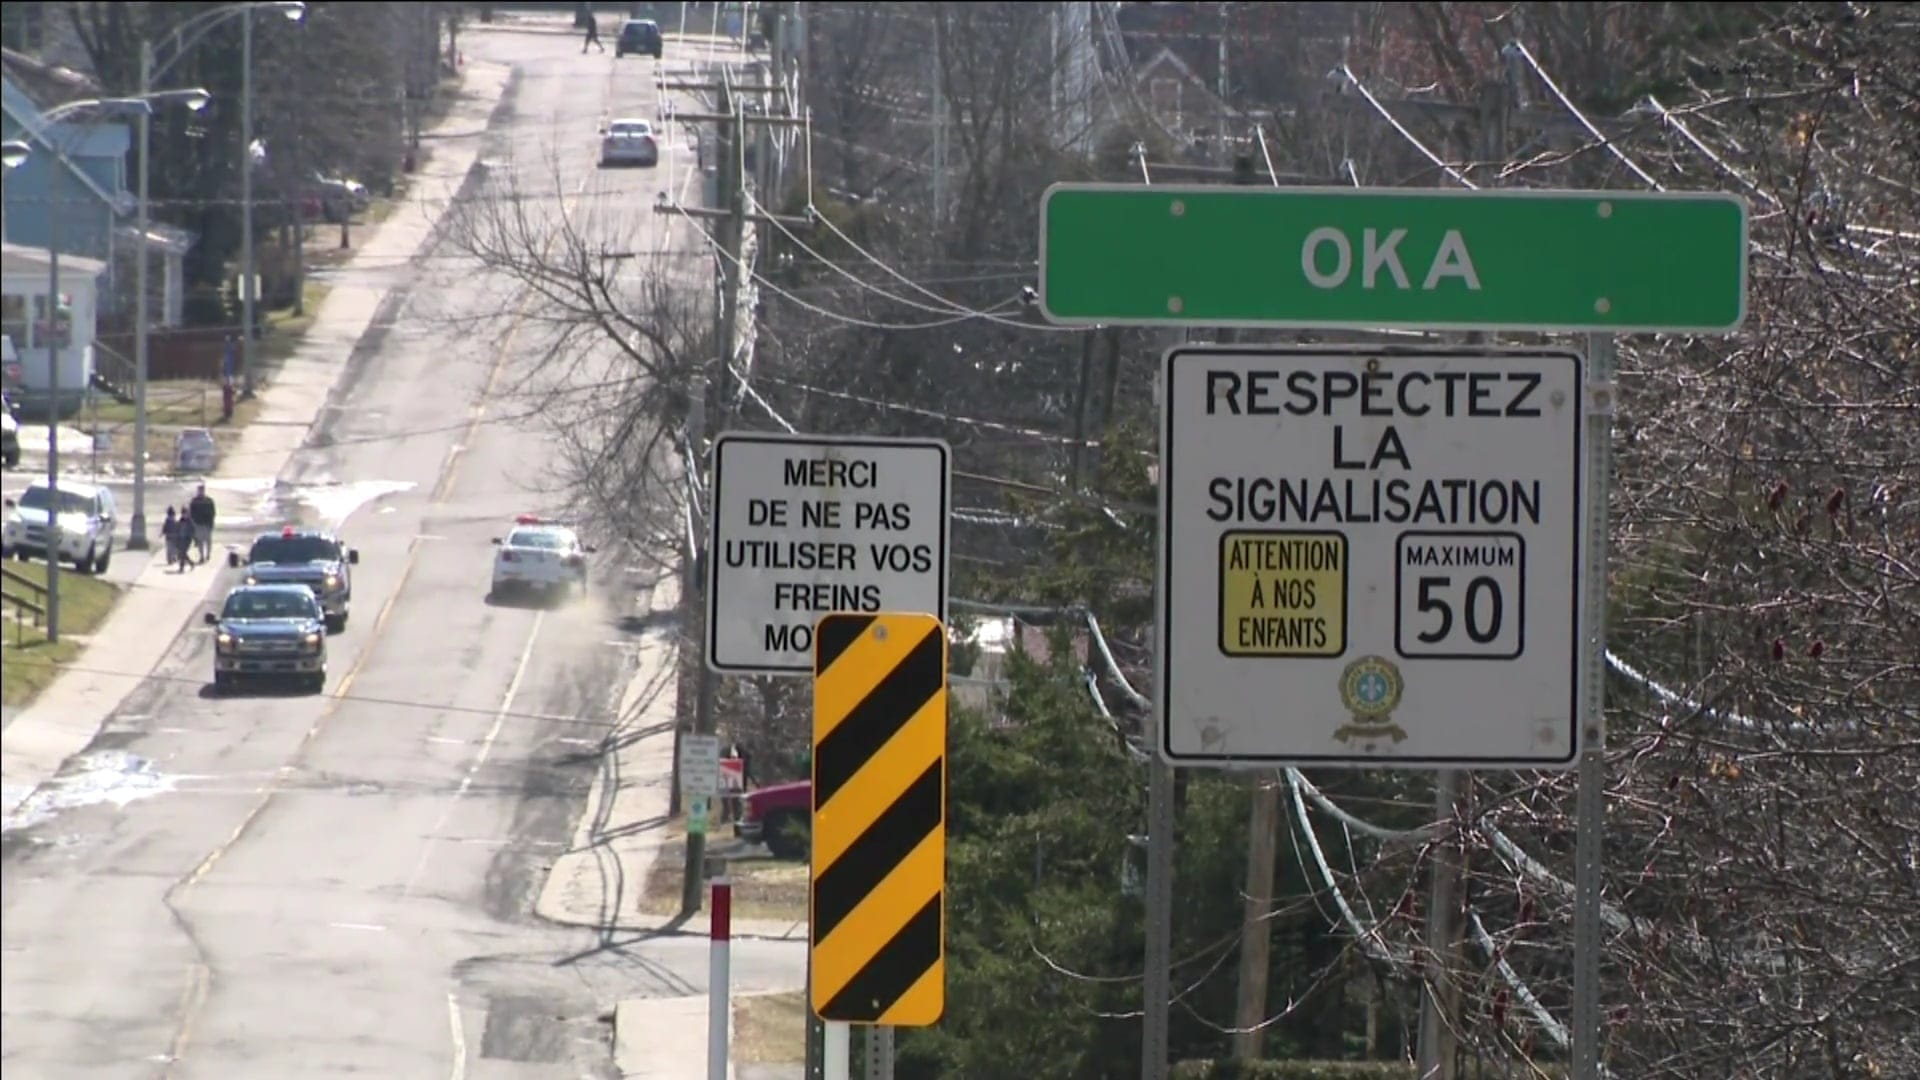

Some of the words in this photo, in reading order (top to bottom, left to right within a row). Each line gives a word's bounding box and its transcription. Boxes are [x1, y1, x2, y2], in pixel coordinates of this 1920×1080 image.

[1301, 226, 1482, 290] OKA
[1206, 370, 1542, 418] RESPECTEZ
[1333, 425, 1412, 470] LA
[784, 459, 877, 488] MERCI
[749, 500, 787, 528] DE
[802, 501, 841, 529] NE
[855, 503, 911, 531] PAS
[1206, 478, 1540, 525] SIGNALISATION
[726, 540, 856, 571] UTILISER
[871, 544, 932, 573] VOS
[1229, 540, 1339, 571] ATTENTION
[1407, 546, 1514, 567] MAXIMUM
[774, 583, 881, 613] FREINS
[1250, 572, 1265, 609] À
[1274, 579, 1316, 610] NOS
[1417, 575, 1503, 644] 50
[1238, 617, 1326, 648] ENFANTS
